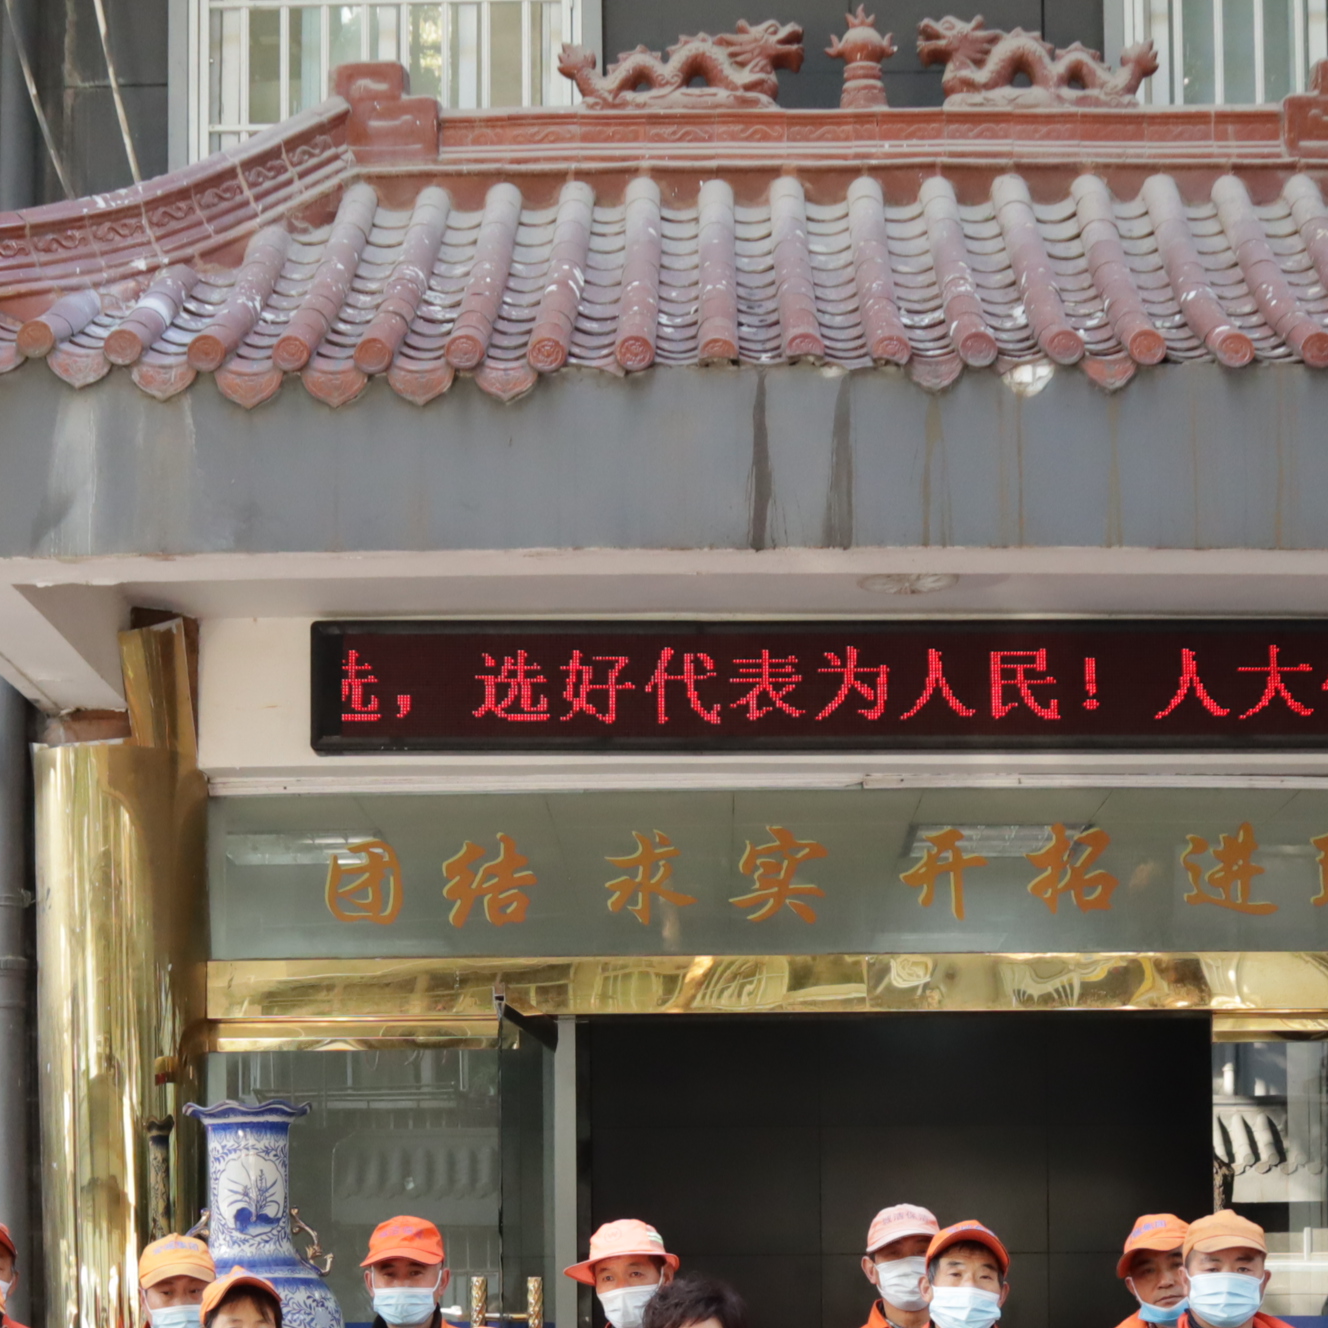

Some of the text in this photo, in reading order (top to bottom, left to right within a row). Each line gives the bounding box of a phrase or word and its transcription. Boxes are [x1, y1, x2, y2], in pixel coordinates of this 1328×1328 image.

[325, 832, 538, 929] 团结
[605, 825, 829, 925] 求实
[899, 823, 1119, 921] 开拓
